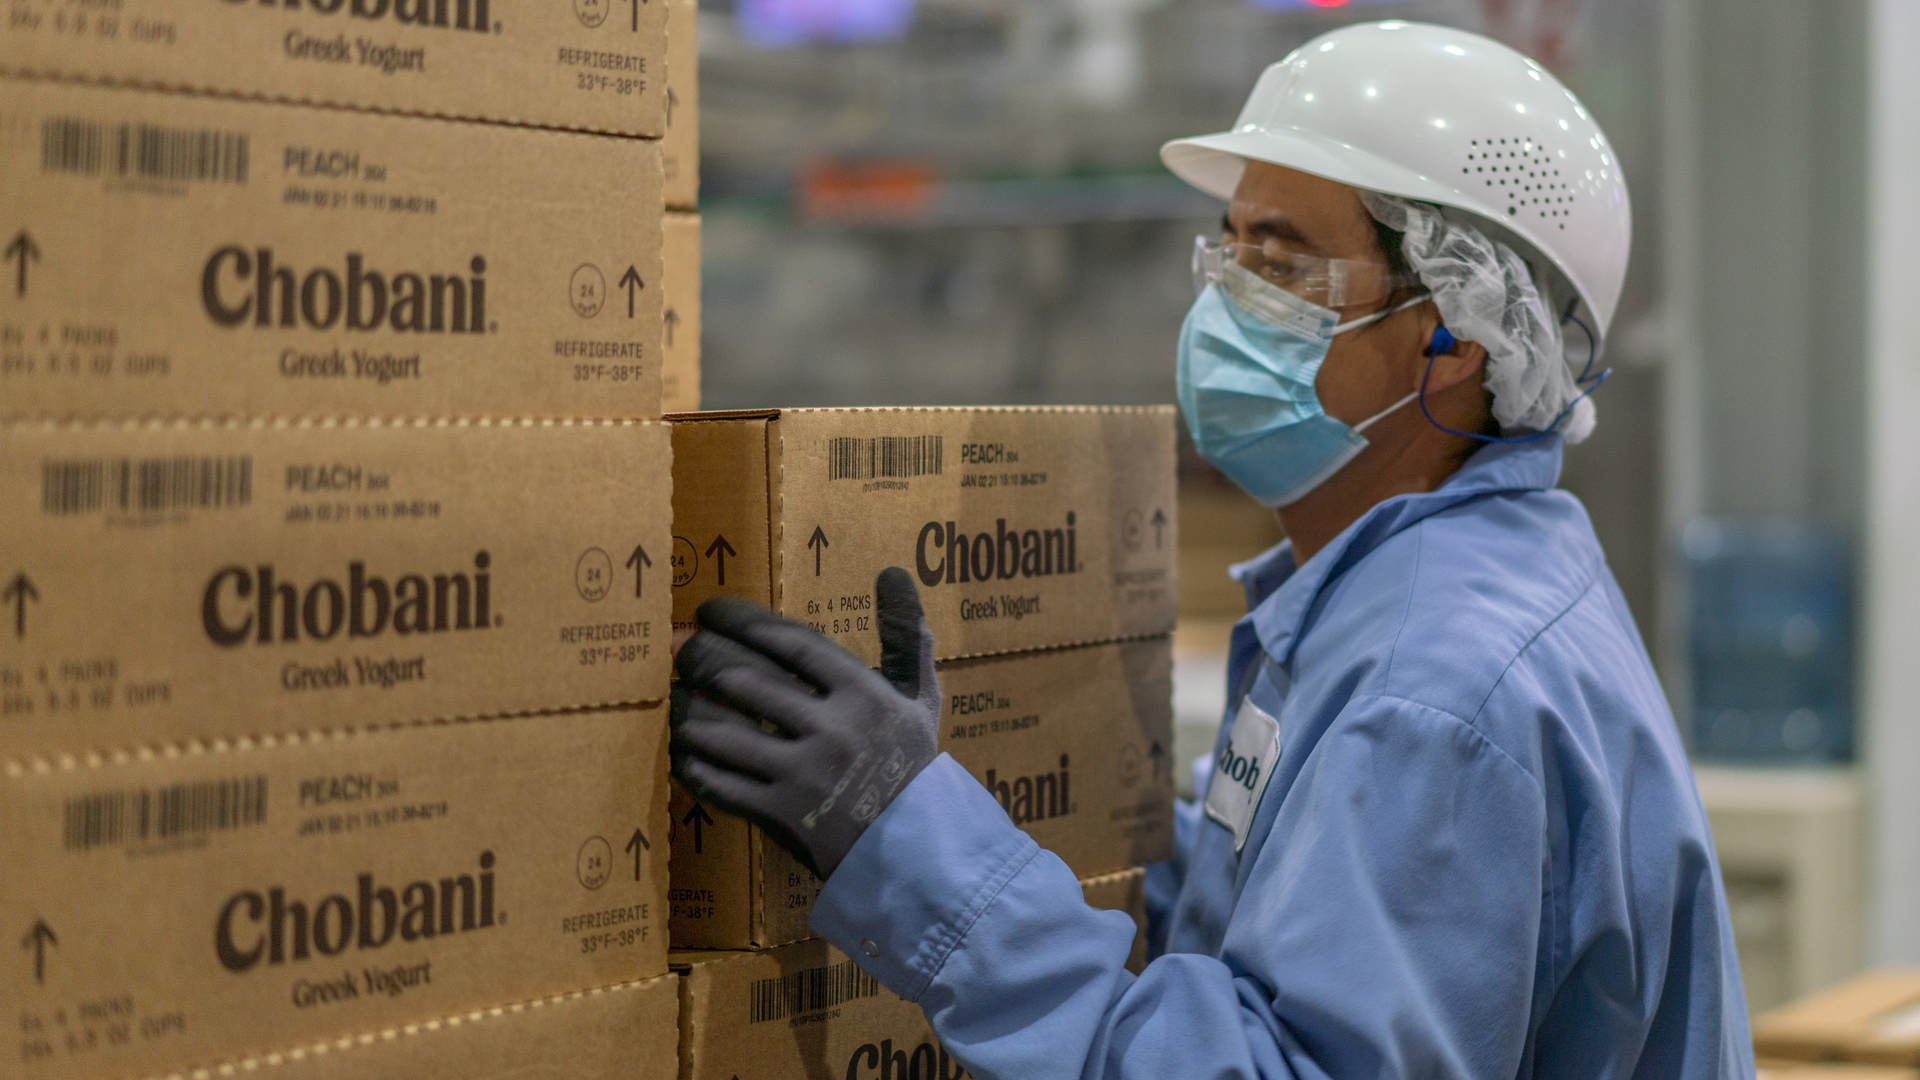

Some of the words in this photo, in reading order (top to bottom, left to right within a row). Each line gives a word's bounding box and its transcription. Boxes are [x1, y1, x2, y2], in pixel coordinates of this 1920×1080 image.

[284, 28, 350, 63] Greek
[356, 36, 426, 75] Yogurt
[558, 47, 647, 73] REFRIGERATE
[284, 146, 360, 178] PEACH
[202, 246, 487, 334] Chobani
[555, 340, 644, 359] REFRIGERATE
[279, 350, 348, 379] Greek
[352, 350, 421, 385] Yogurt
[574, 363, 644, 381] 33°F-38°F
[962, 443, 1003, 464] PEACH
[285, 464, 362, 493] PEACH
[961, 474, 977, 487] JAN
[978, 475, 987, 488] 02
[988, 474, 997, 488] 21
[671, 555, 685, 567] 24
[916, 511, 1076, 587] Chobani
[673, 572, 689, 583] UPS
[203, 549, 491, 647] Chobani
[807, 600, 820, 615] 6x
[826, 599, 834, 612] 4
[840, 595, 871, 611] PACKS
[960, 596, 998, 620] Greek
[999, 595, 1040, 620] Yogurt
[561, 621, 650, 643] REFRIGERATE
[833, 616, 850, 634] 5.3
[856, 616, 869, 631] OZ
[580, 644, 650, 666] 33°F-38°F
[281, 657, 349, 691] Greek
[355, 655, 425, 689] Yogurt
[952, 690, 994, 715] PEACH
[950, 725, 967, 738] JAN
[300, 773, 372, 808] PEACH
[788, 873, 801, 887] 6x
[215, 850, 496, 974] Chobani
[788, 894, 808, 909] 24x
[563, 904, 649, 934] REFRIGERATE
[581, 926, 649, 955] 33°F-38°F
[362, 959, 431, 997] Yogurt
